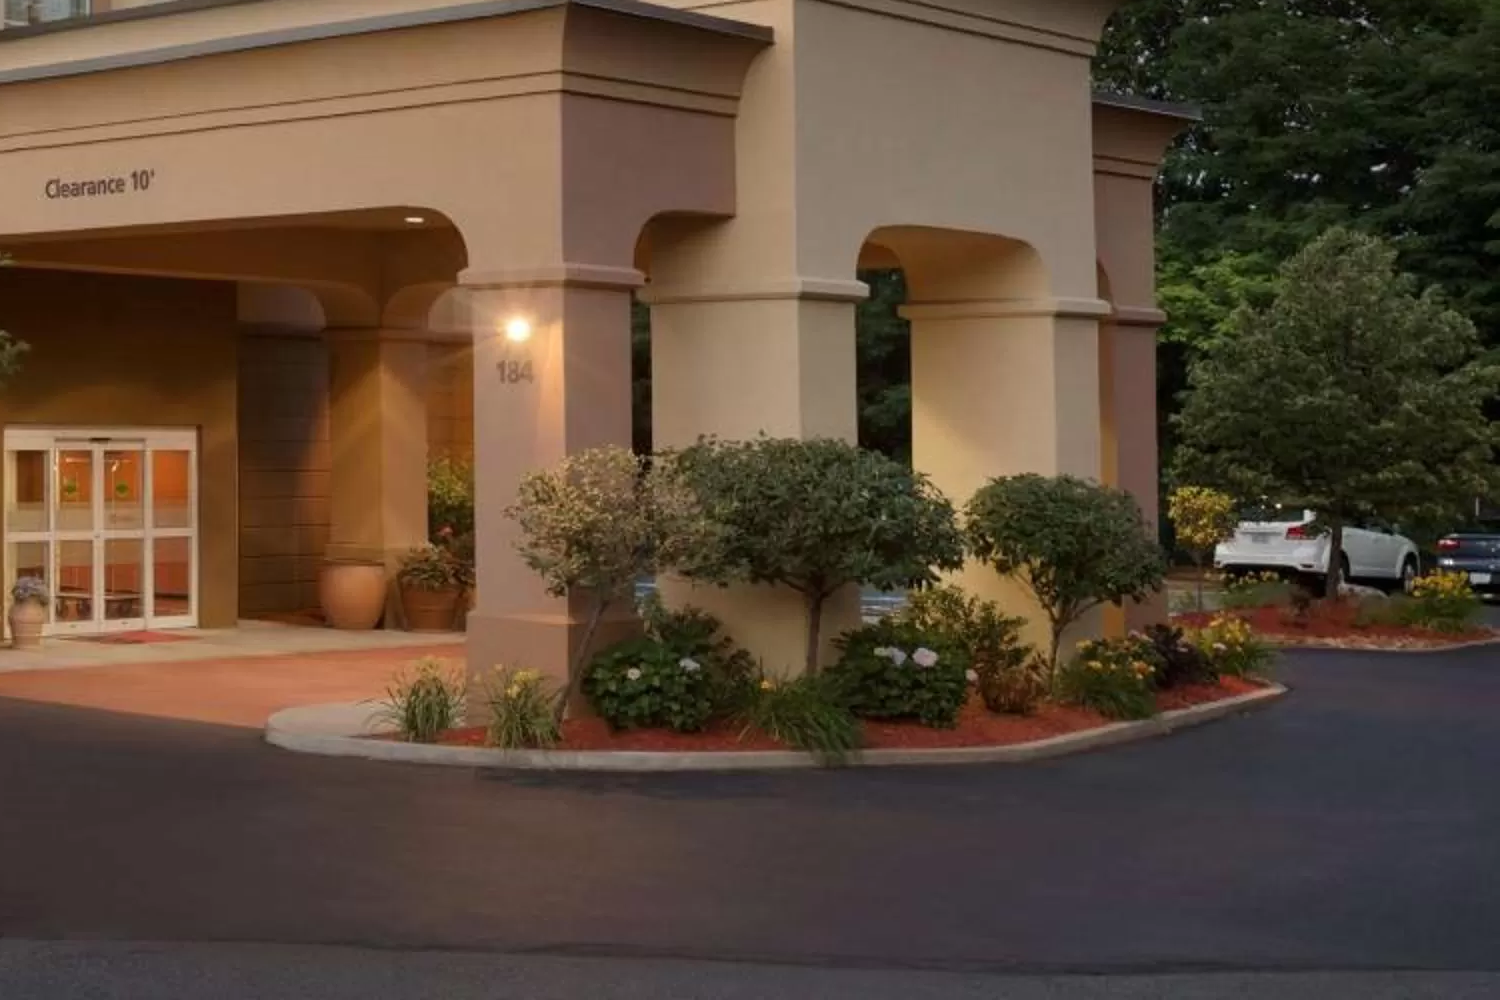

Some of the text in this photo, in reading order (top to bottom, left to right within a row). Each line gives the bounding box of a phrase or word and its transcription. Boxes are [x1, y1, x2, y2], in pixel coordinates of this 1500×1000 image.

[45, 167, 155, 199] Clearance 10'
[496, 359, 534, 385] 184
